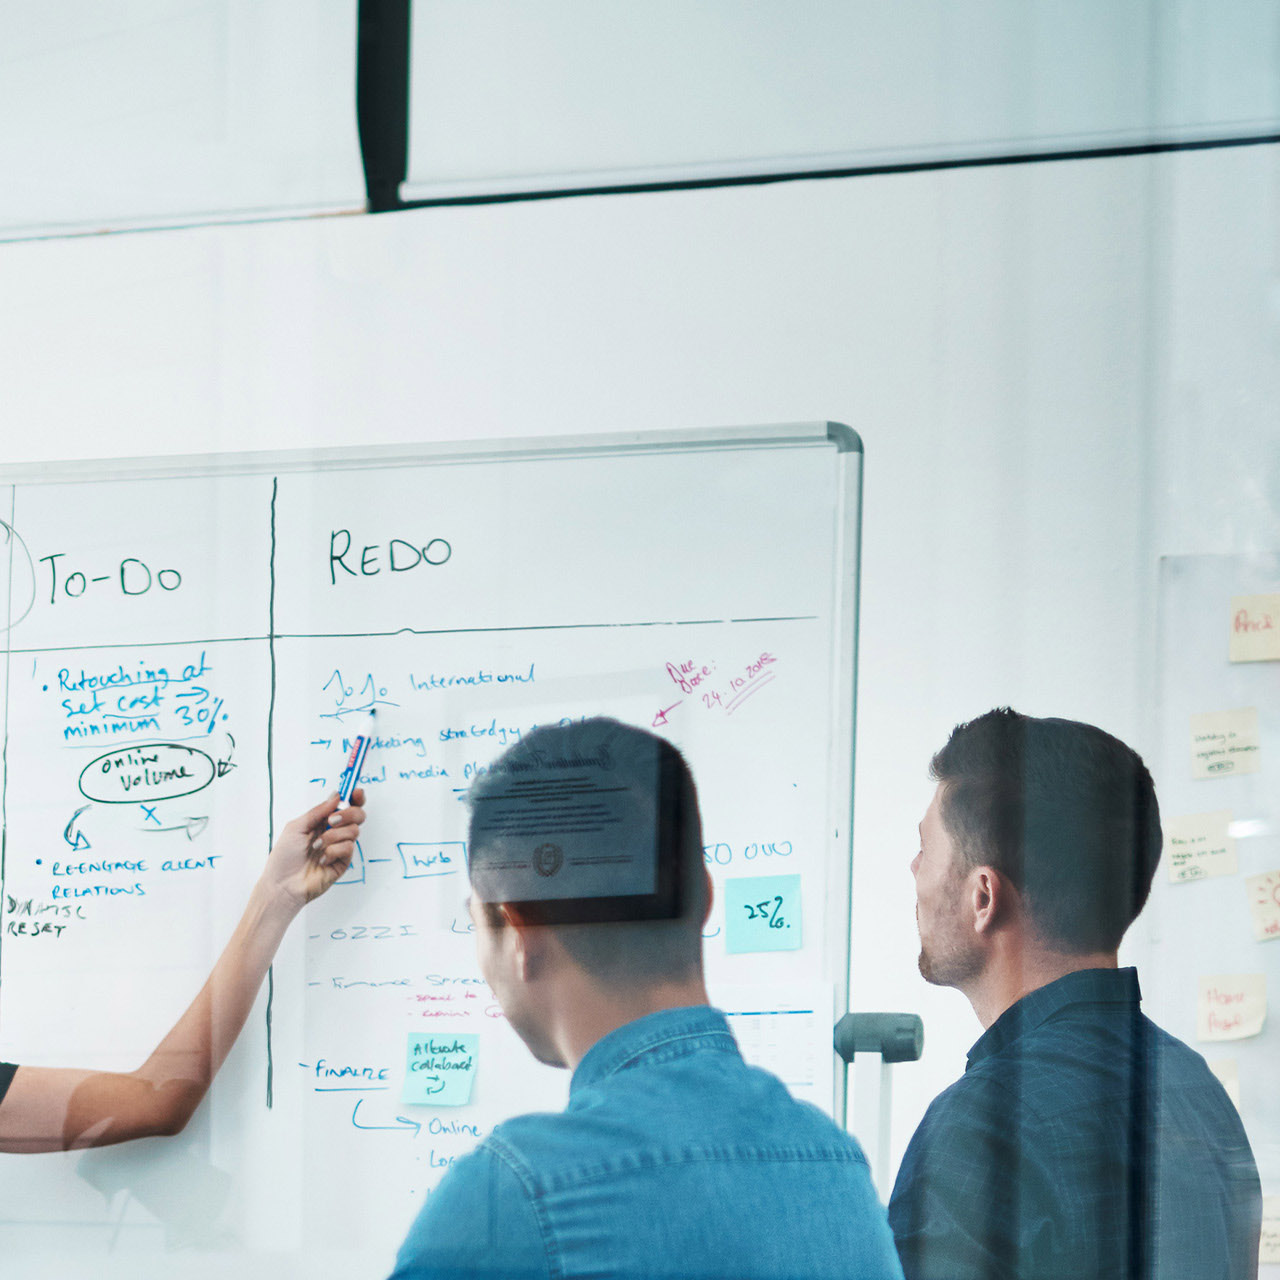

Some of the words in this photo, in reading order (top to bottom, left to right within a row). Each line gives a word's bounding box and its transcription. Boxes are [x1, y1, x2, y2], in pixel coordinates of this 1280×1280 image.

[330, 529, 453, 585] REDO
[38, 553, 183, 604] To-Do
[51, 883, 147, 901] RELATIONS
[428, 1117, 483, 1138] Online
